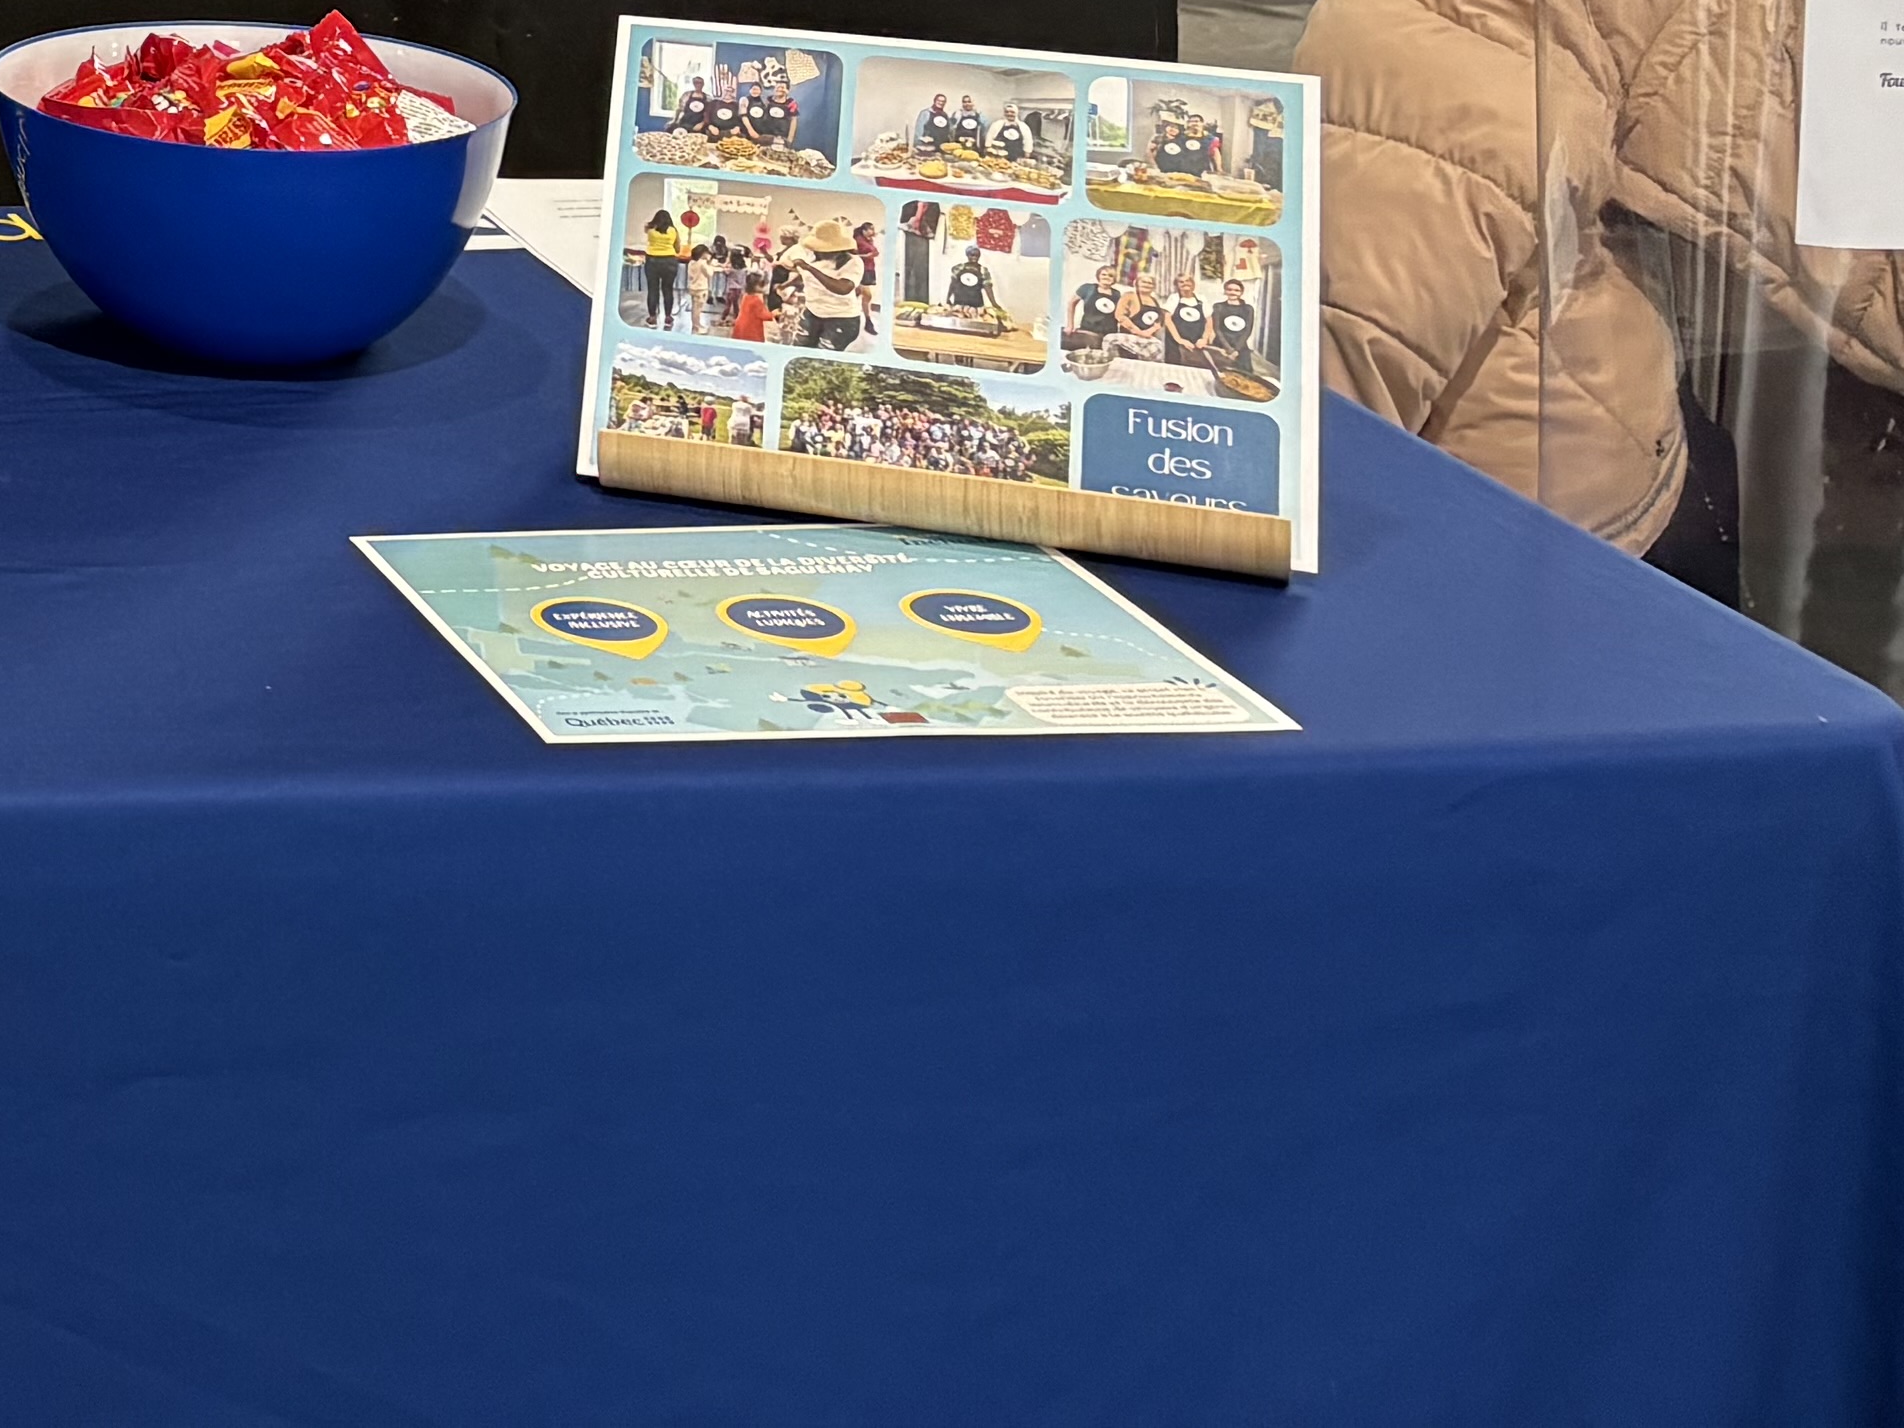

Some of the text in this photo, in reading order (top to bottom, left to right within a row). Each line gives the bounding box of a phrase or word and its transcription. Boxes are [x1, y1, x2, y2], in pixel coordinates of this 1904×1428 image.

[1128, 408, 1233, 446] Fusion
[1147, 447, 1212, 480] des
[531, 560, 622, 573] VOYAGE
[627, 560, 658, 571] AU
[739, 558, 765, 568] DE
[766, 557, 793, 567] LA
[586, 568, 722, 579] CULTURELLE
[727, 567, 753, 577] DE
